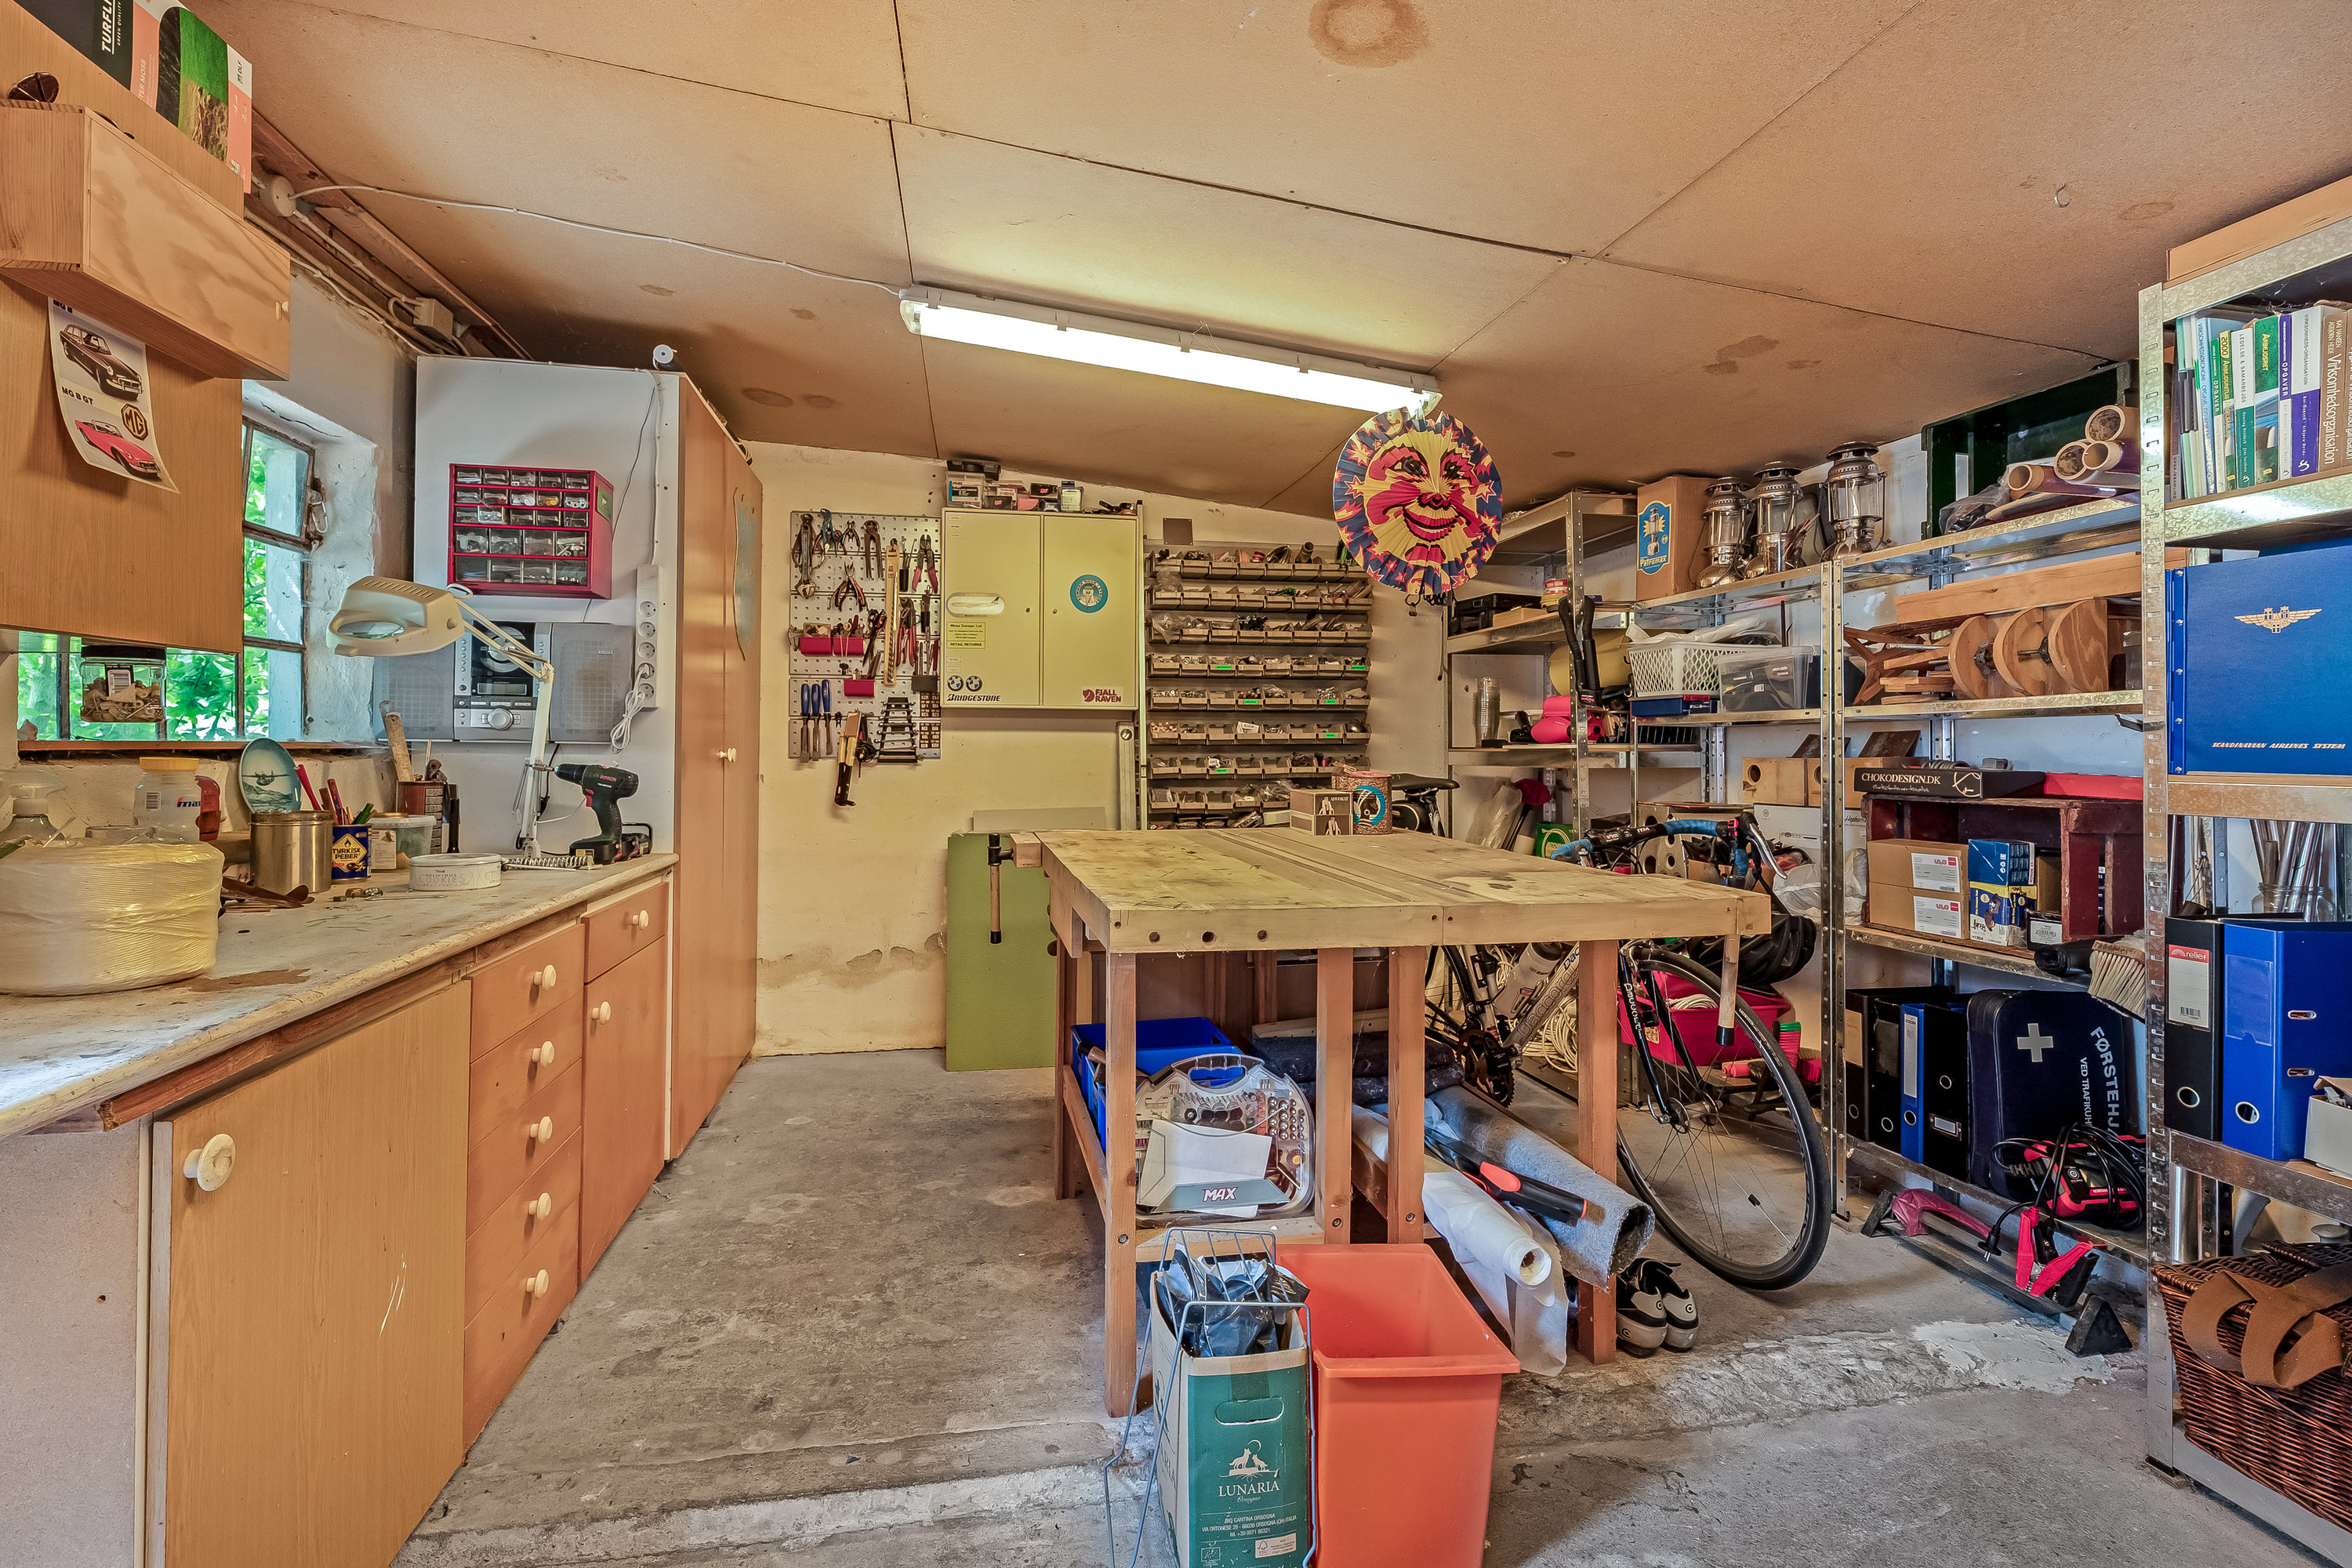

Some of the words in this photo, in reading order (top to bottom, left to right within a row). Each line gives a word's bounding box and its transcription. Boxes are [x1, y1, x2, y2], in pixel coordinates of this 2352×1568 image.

[2262, 333, 2270, 372] ARBEJDSRET
[62, 386, 74, 398] MG
[76, 393, 82, 401] B
[83, 396, 94, 405] GT
[2323, 354, 2342, 465] Virksomhedsorganisation
[124, 408, 145, 435] MG
[1639, 555, 1667, 568] Petromax
[946, 693, 1002, 702] BRIDGESTONE
[1861, 772, 1941, 785] CHOKODESIGN.DK
[2186, 951, 2207, 960] relief
[2080, 1057, 2089, 1077] VED
[2089, 1025, 2120, 1131] FØRSTEHJ
[1203, 1187, 1239, 1203] MAX
[1218, 1480, 1279, 1497] LUNARIA
